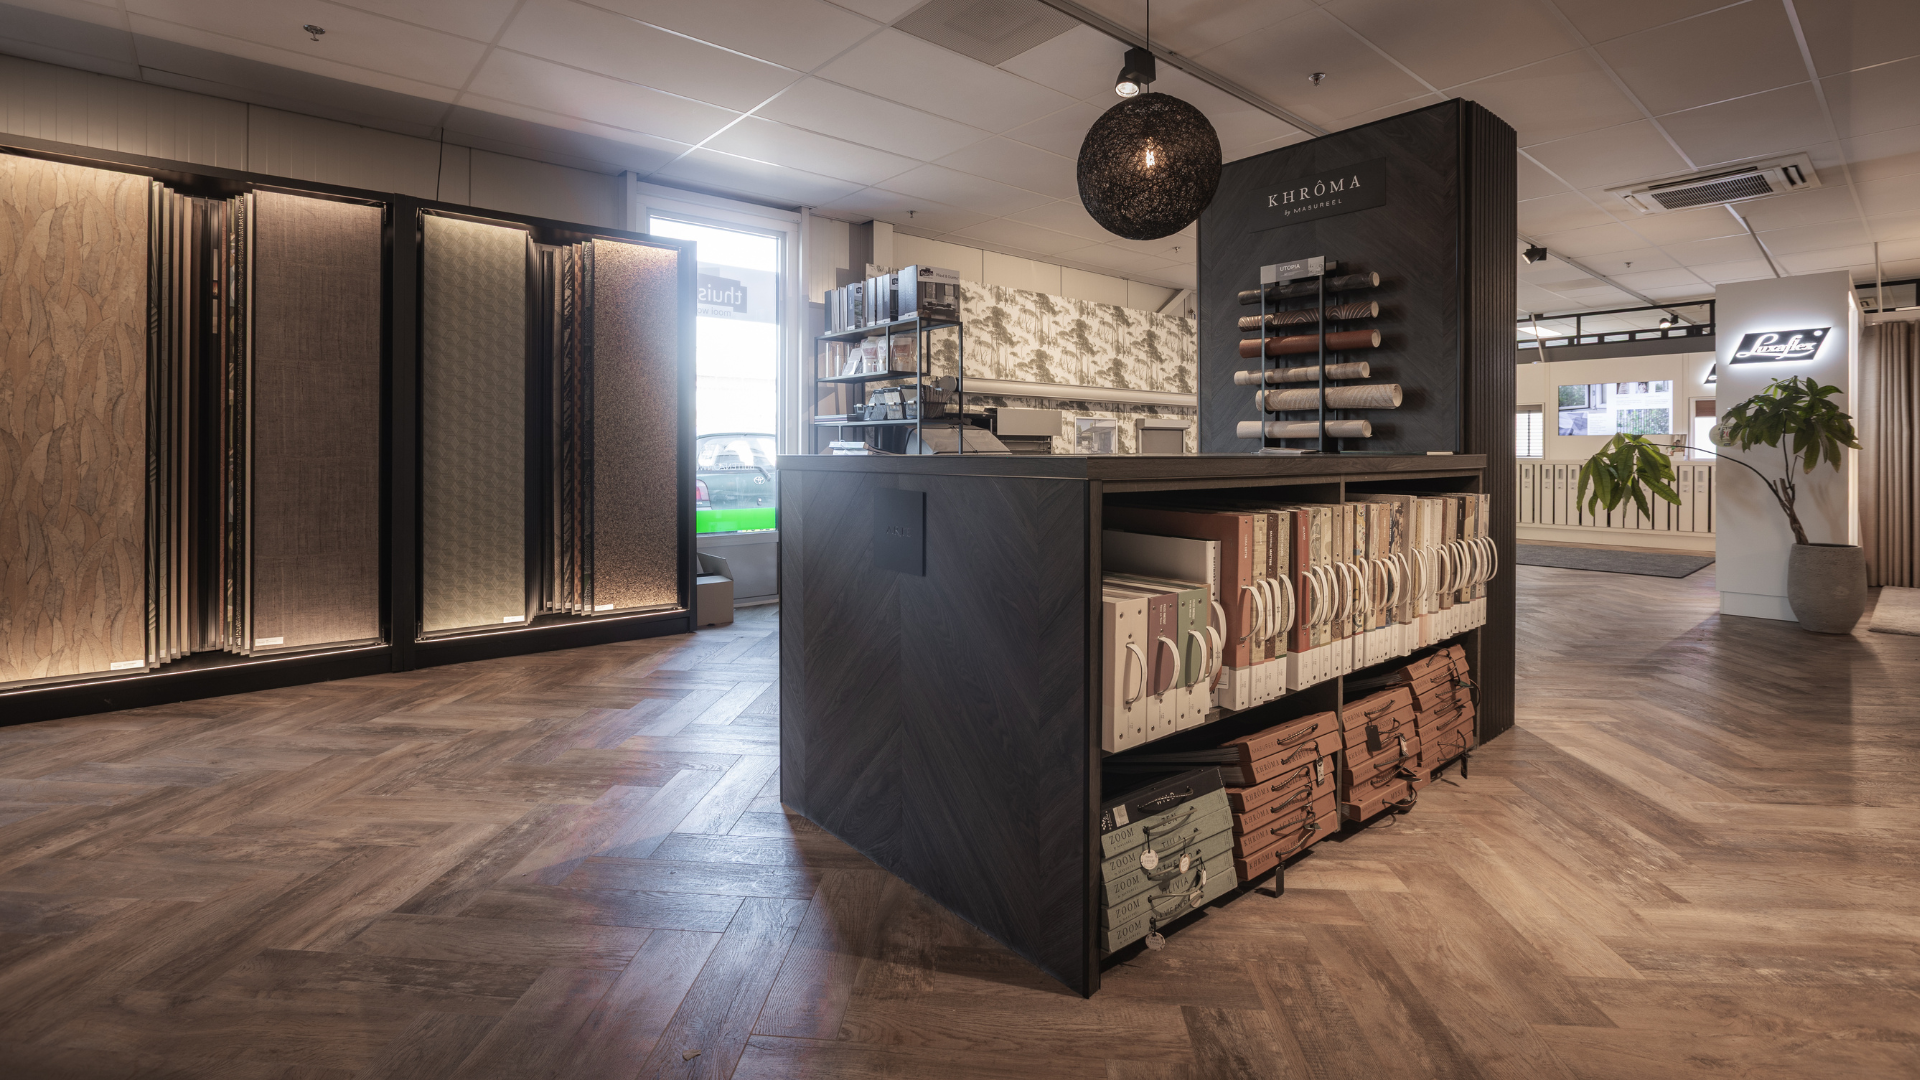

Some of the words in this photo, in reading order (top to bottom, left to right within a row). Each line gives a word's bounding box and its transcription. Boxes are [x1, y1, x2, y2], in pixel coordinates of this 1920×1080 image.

[1268, 175, 1361, 208] KHRÔMA
[1284, 209, 1291, 217] by
[1293, 198, 1342, 214] MASUREEL
[1279, 263, 1301, 272] UTOPIA
[1735, 333, 1817, 360] Luxaflex
[885, 525, 913, 538] ARTE
[1254, 760, 1280, 775] KHRÔMA
[1245, 788, 1270, 803] KHRÔMA
[1243, 809, 1269, 826] KHRÔMA
[1109, 828, 1135, 846] ZOOM
[1243, 830, 1269, 848] KHRÔMA
[1109, 853, 1136, 871] ZOOM
[1249, 852, 1274, 870] KHRÔMA
[1114, 875, 1140, 894] ZOOM
[1115, 899, 1141, 919] ZOOM
[1117, 921, 1143, 940] ZOOM
